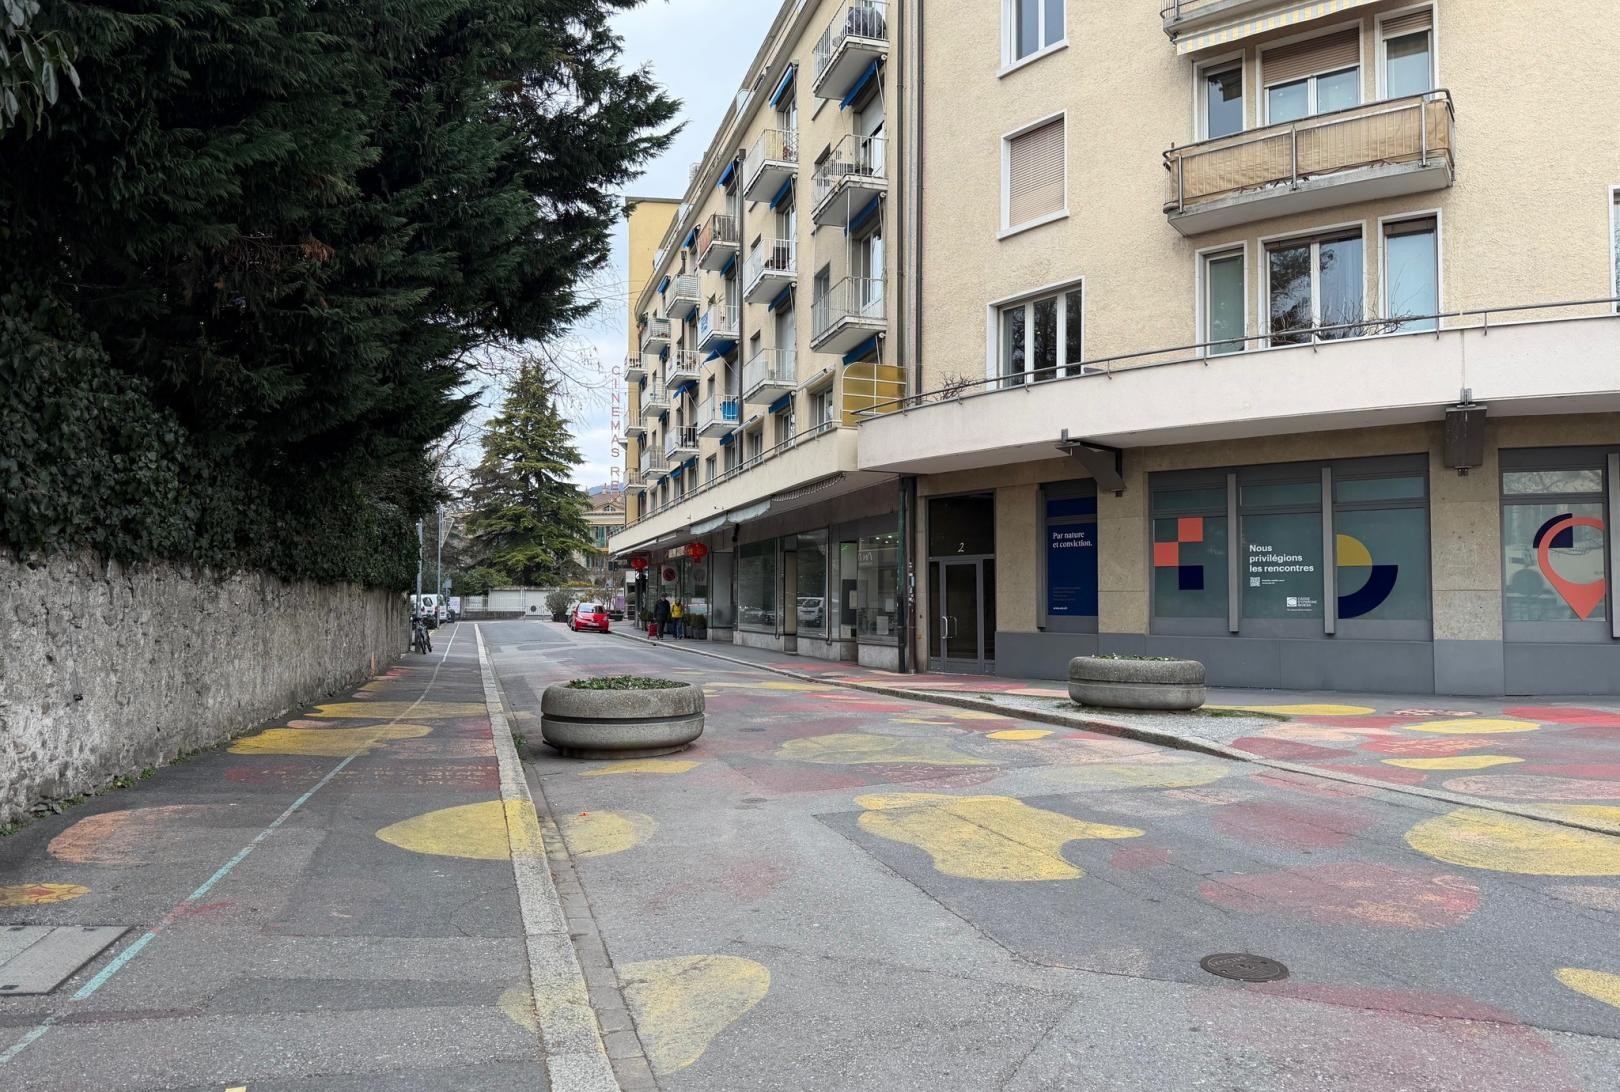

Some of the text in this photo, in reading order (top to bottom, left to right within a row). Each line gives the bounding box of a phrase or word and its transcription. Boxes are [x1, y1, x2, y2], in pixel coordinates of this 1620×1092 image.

[611, 365, 621, 458] CINEMAS
[957, 542, 965, 552] 2
[1059, 540, 1092, 548] conviction.
[1249, 544, 1272, 552] Nous
[1249, 554, 1303, 563] privilégions
[1249, 564, 1314, 573] les rencontres
